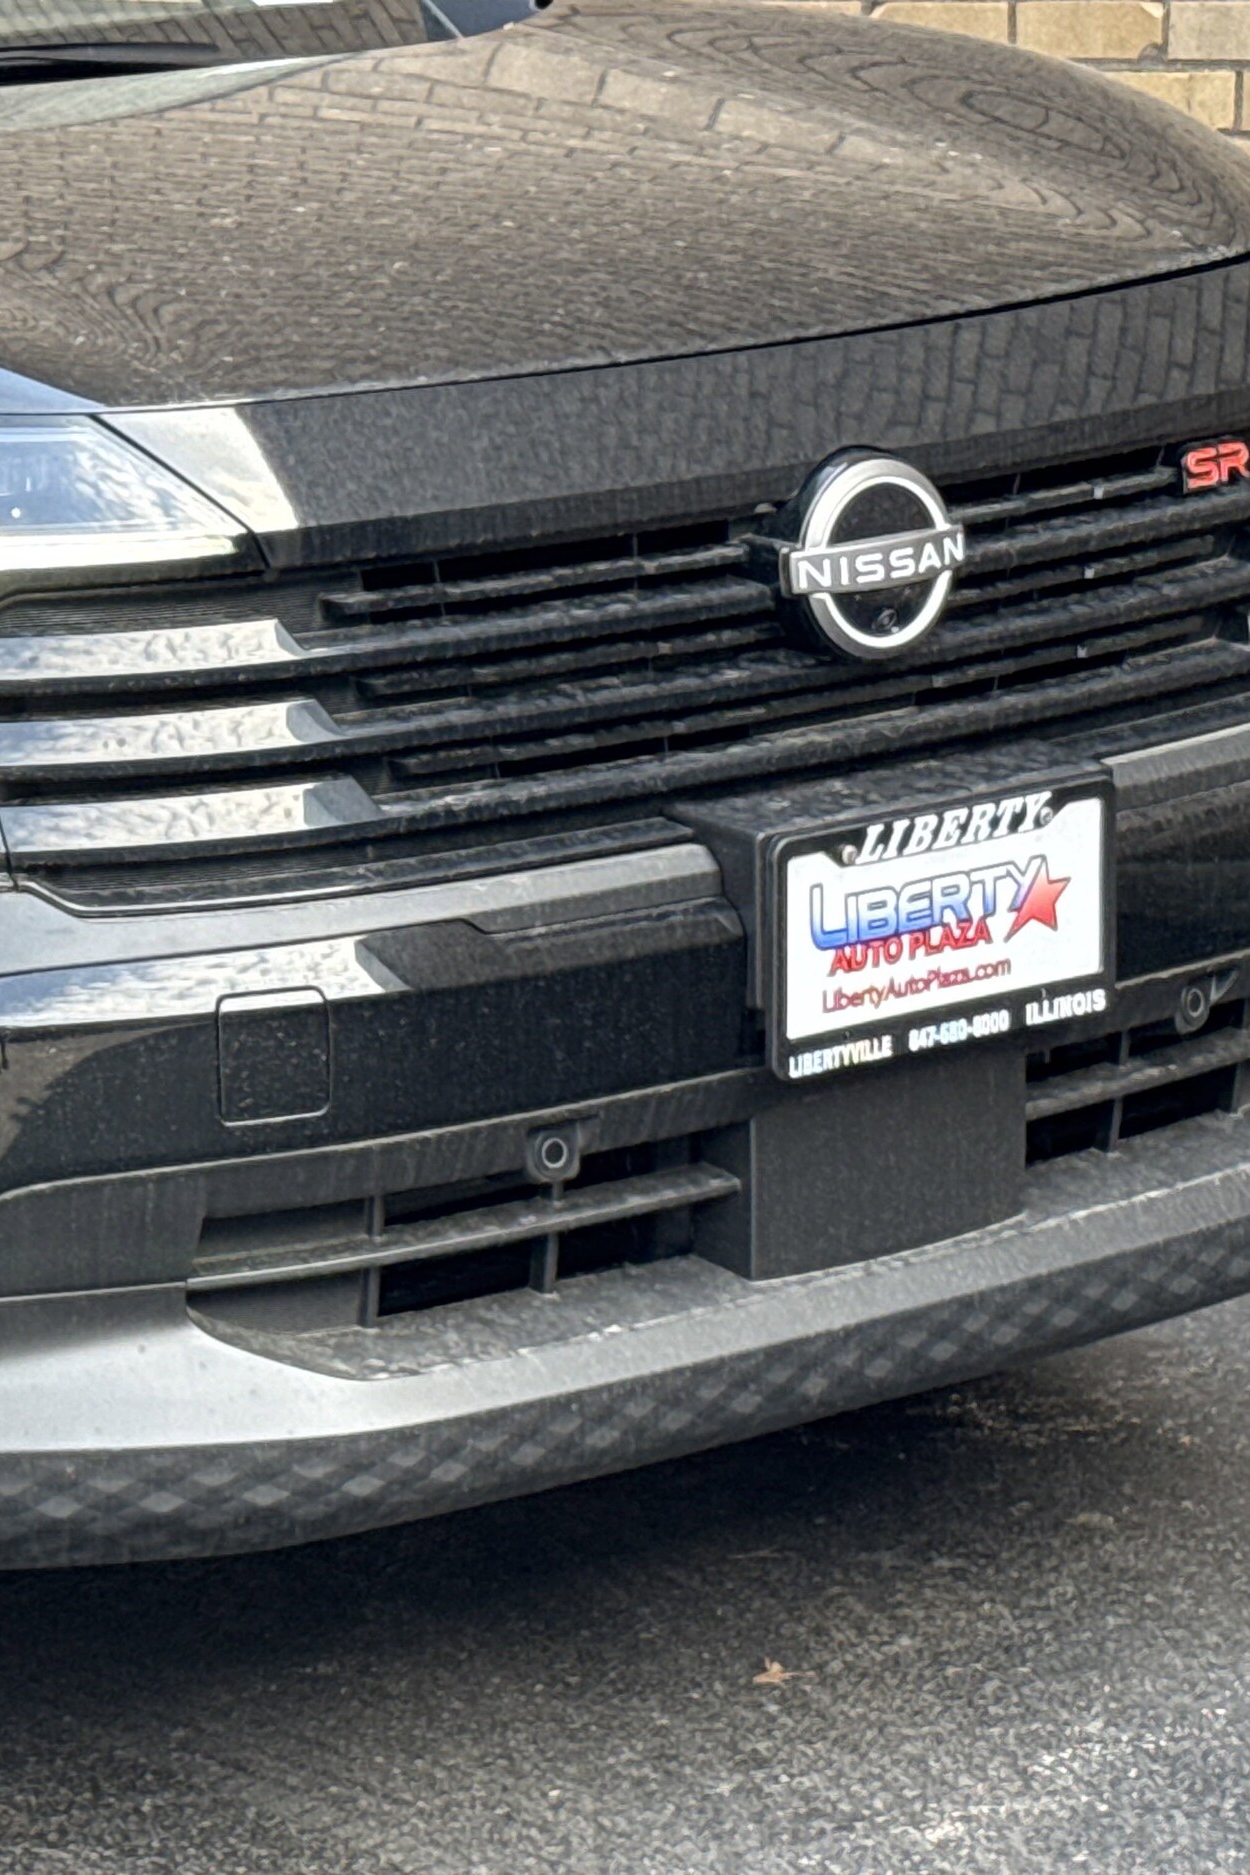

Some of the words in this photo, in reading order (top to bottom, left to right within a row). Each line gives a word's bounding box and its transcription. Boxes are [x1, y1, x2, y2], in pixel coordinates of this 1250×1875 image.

[1187, 441, 1250, 490] SR
[797, 531, 965, 590] NISSAN
[855, 790, 1052, 864] LIBERTY
[809, 854, 1047, 951] LIBERTY
[827, 938, 904, 977] AUTO
[908, 916, 994, 961] PLAZA
[822, 958, 1012, 1014] LibertyAutoPlaza.com
[788, 1034, 893, 1080] LIBERTYVILLE
[1025, 988, 1107, 1027] ILLINOIS
